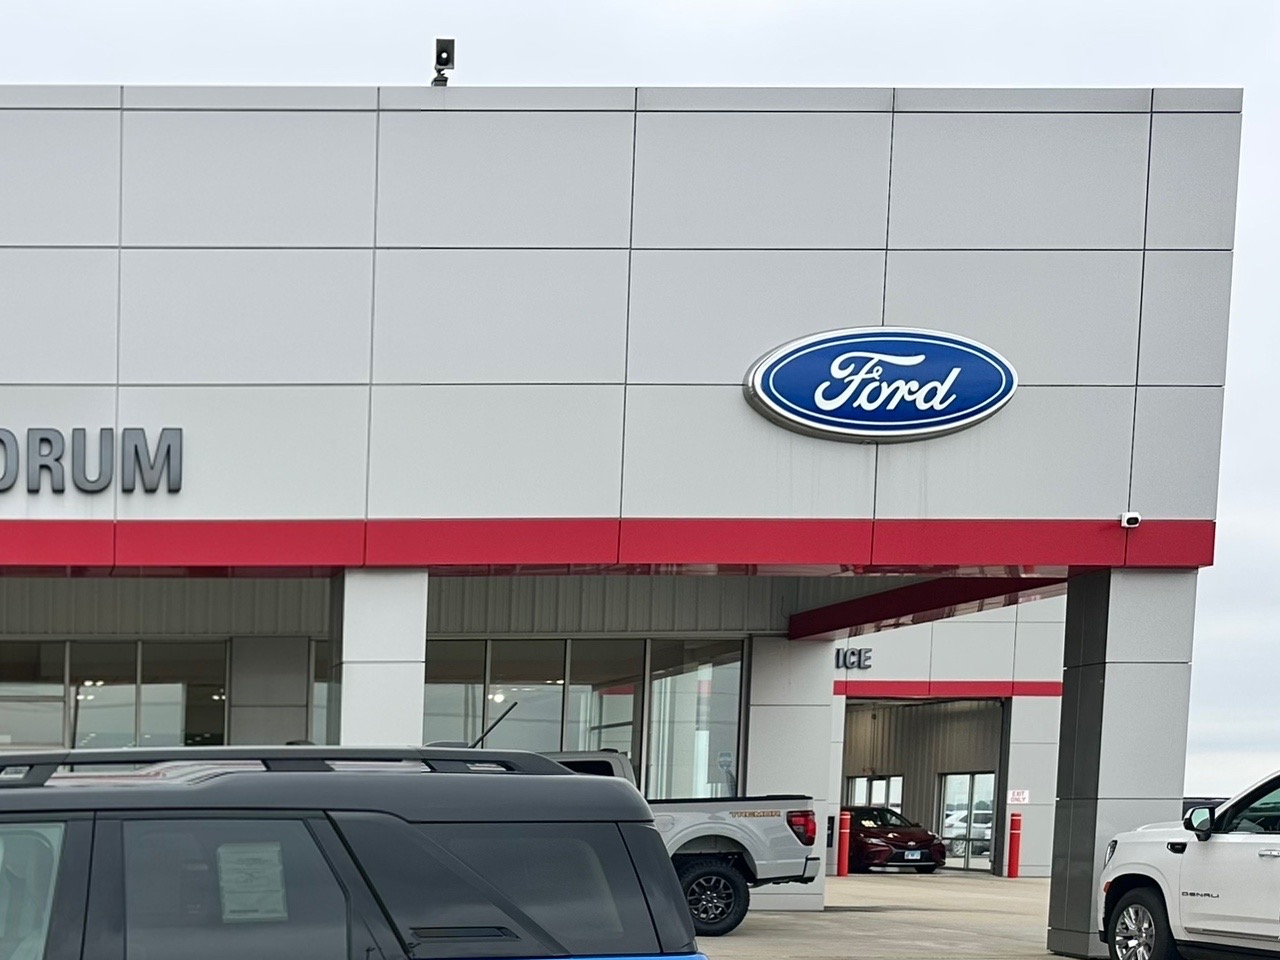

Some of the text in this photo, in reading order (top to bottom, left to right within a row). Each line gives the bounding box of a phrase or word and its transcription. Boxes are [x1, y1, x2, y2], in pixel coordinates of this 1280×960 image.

[814, 351, 962, 411] Ford
[835, 648, 873, 669] ICE
[729, 810, 782, 818] TREMOR
[1181, 891, 1220, 899] DENALI
